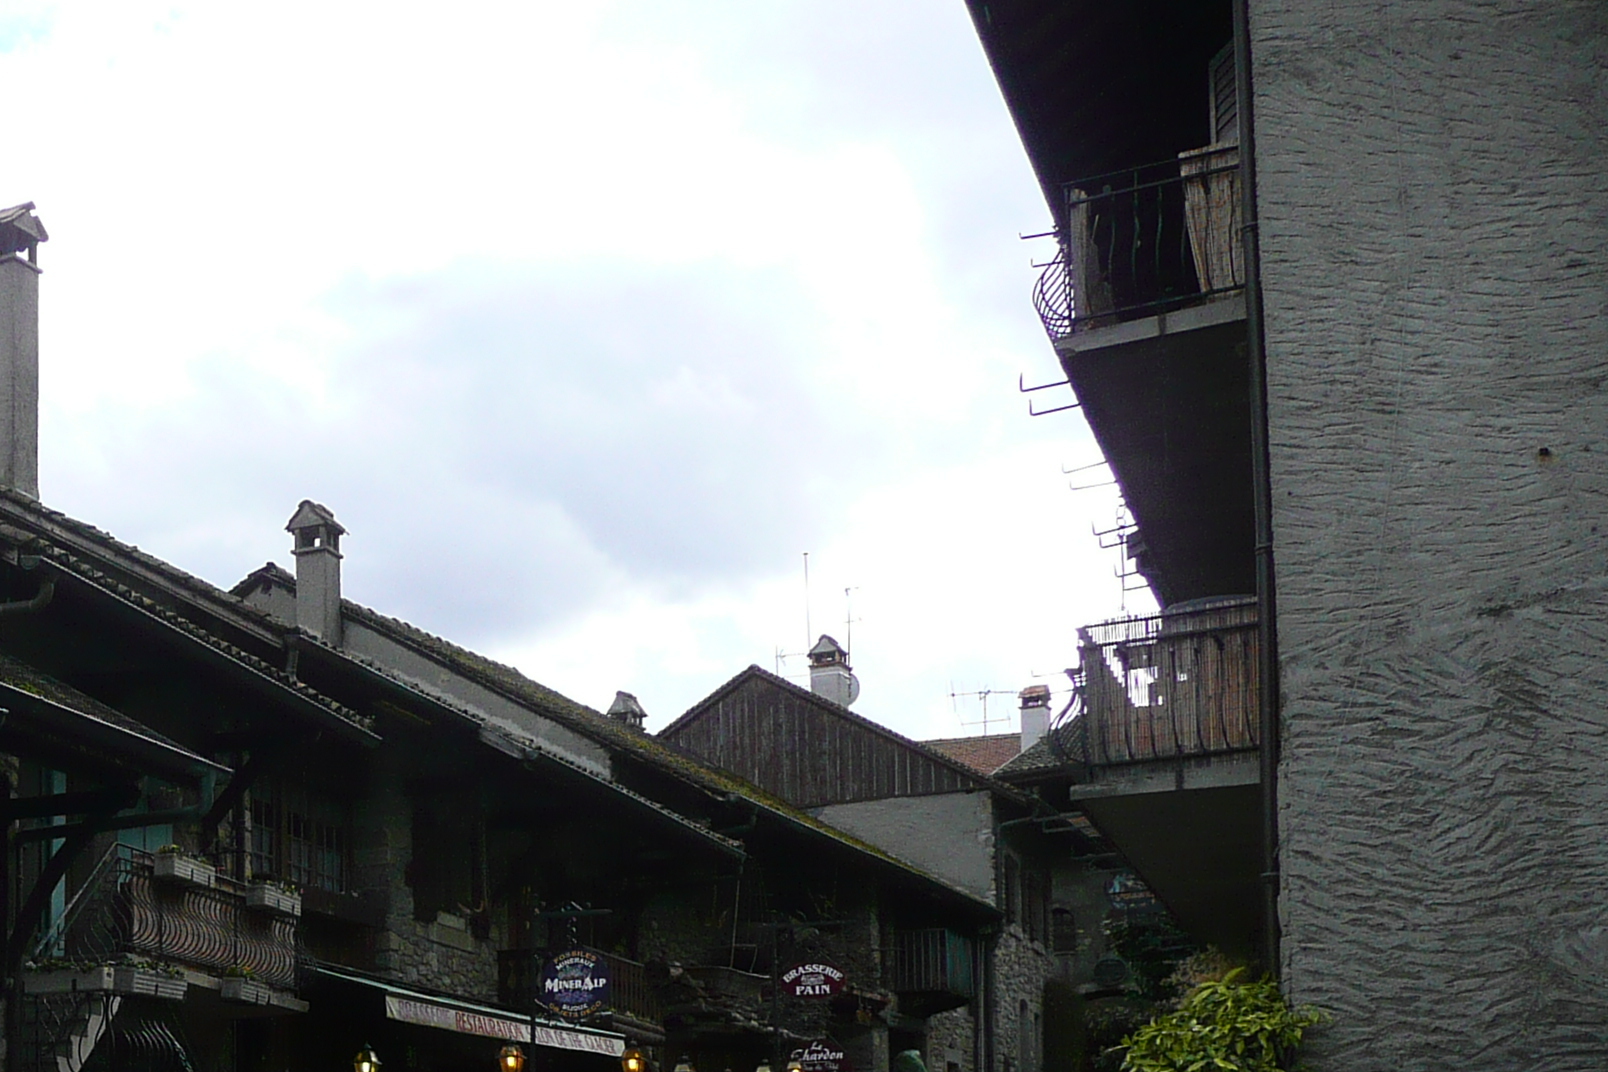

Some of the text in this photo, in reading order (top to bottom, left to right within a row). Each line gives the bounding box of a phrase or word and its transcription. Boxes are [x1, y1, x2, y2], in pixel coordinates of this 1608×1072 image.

[553, 951, 597, 963] FOSSILES
[555, 957, 595, 970] MINERAUX
[783, 963, 844, 983] BRASSERIE
[795, 984, 831, 996] PAIN
[397, 1000, 451, 1024] BRASSERIE
[455, 1011, 525, 1040] RESTAURATION
[525, 1025, 555, 1044] SLON
[554, 1029, 567, 1047] DE
[810, 1041, 823, 1051] Le
[790, 1048, 844, 1063] Chardon
